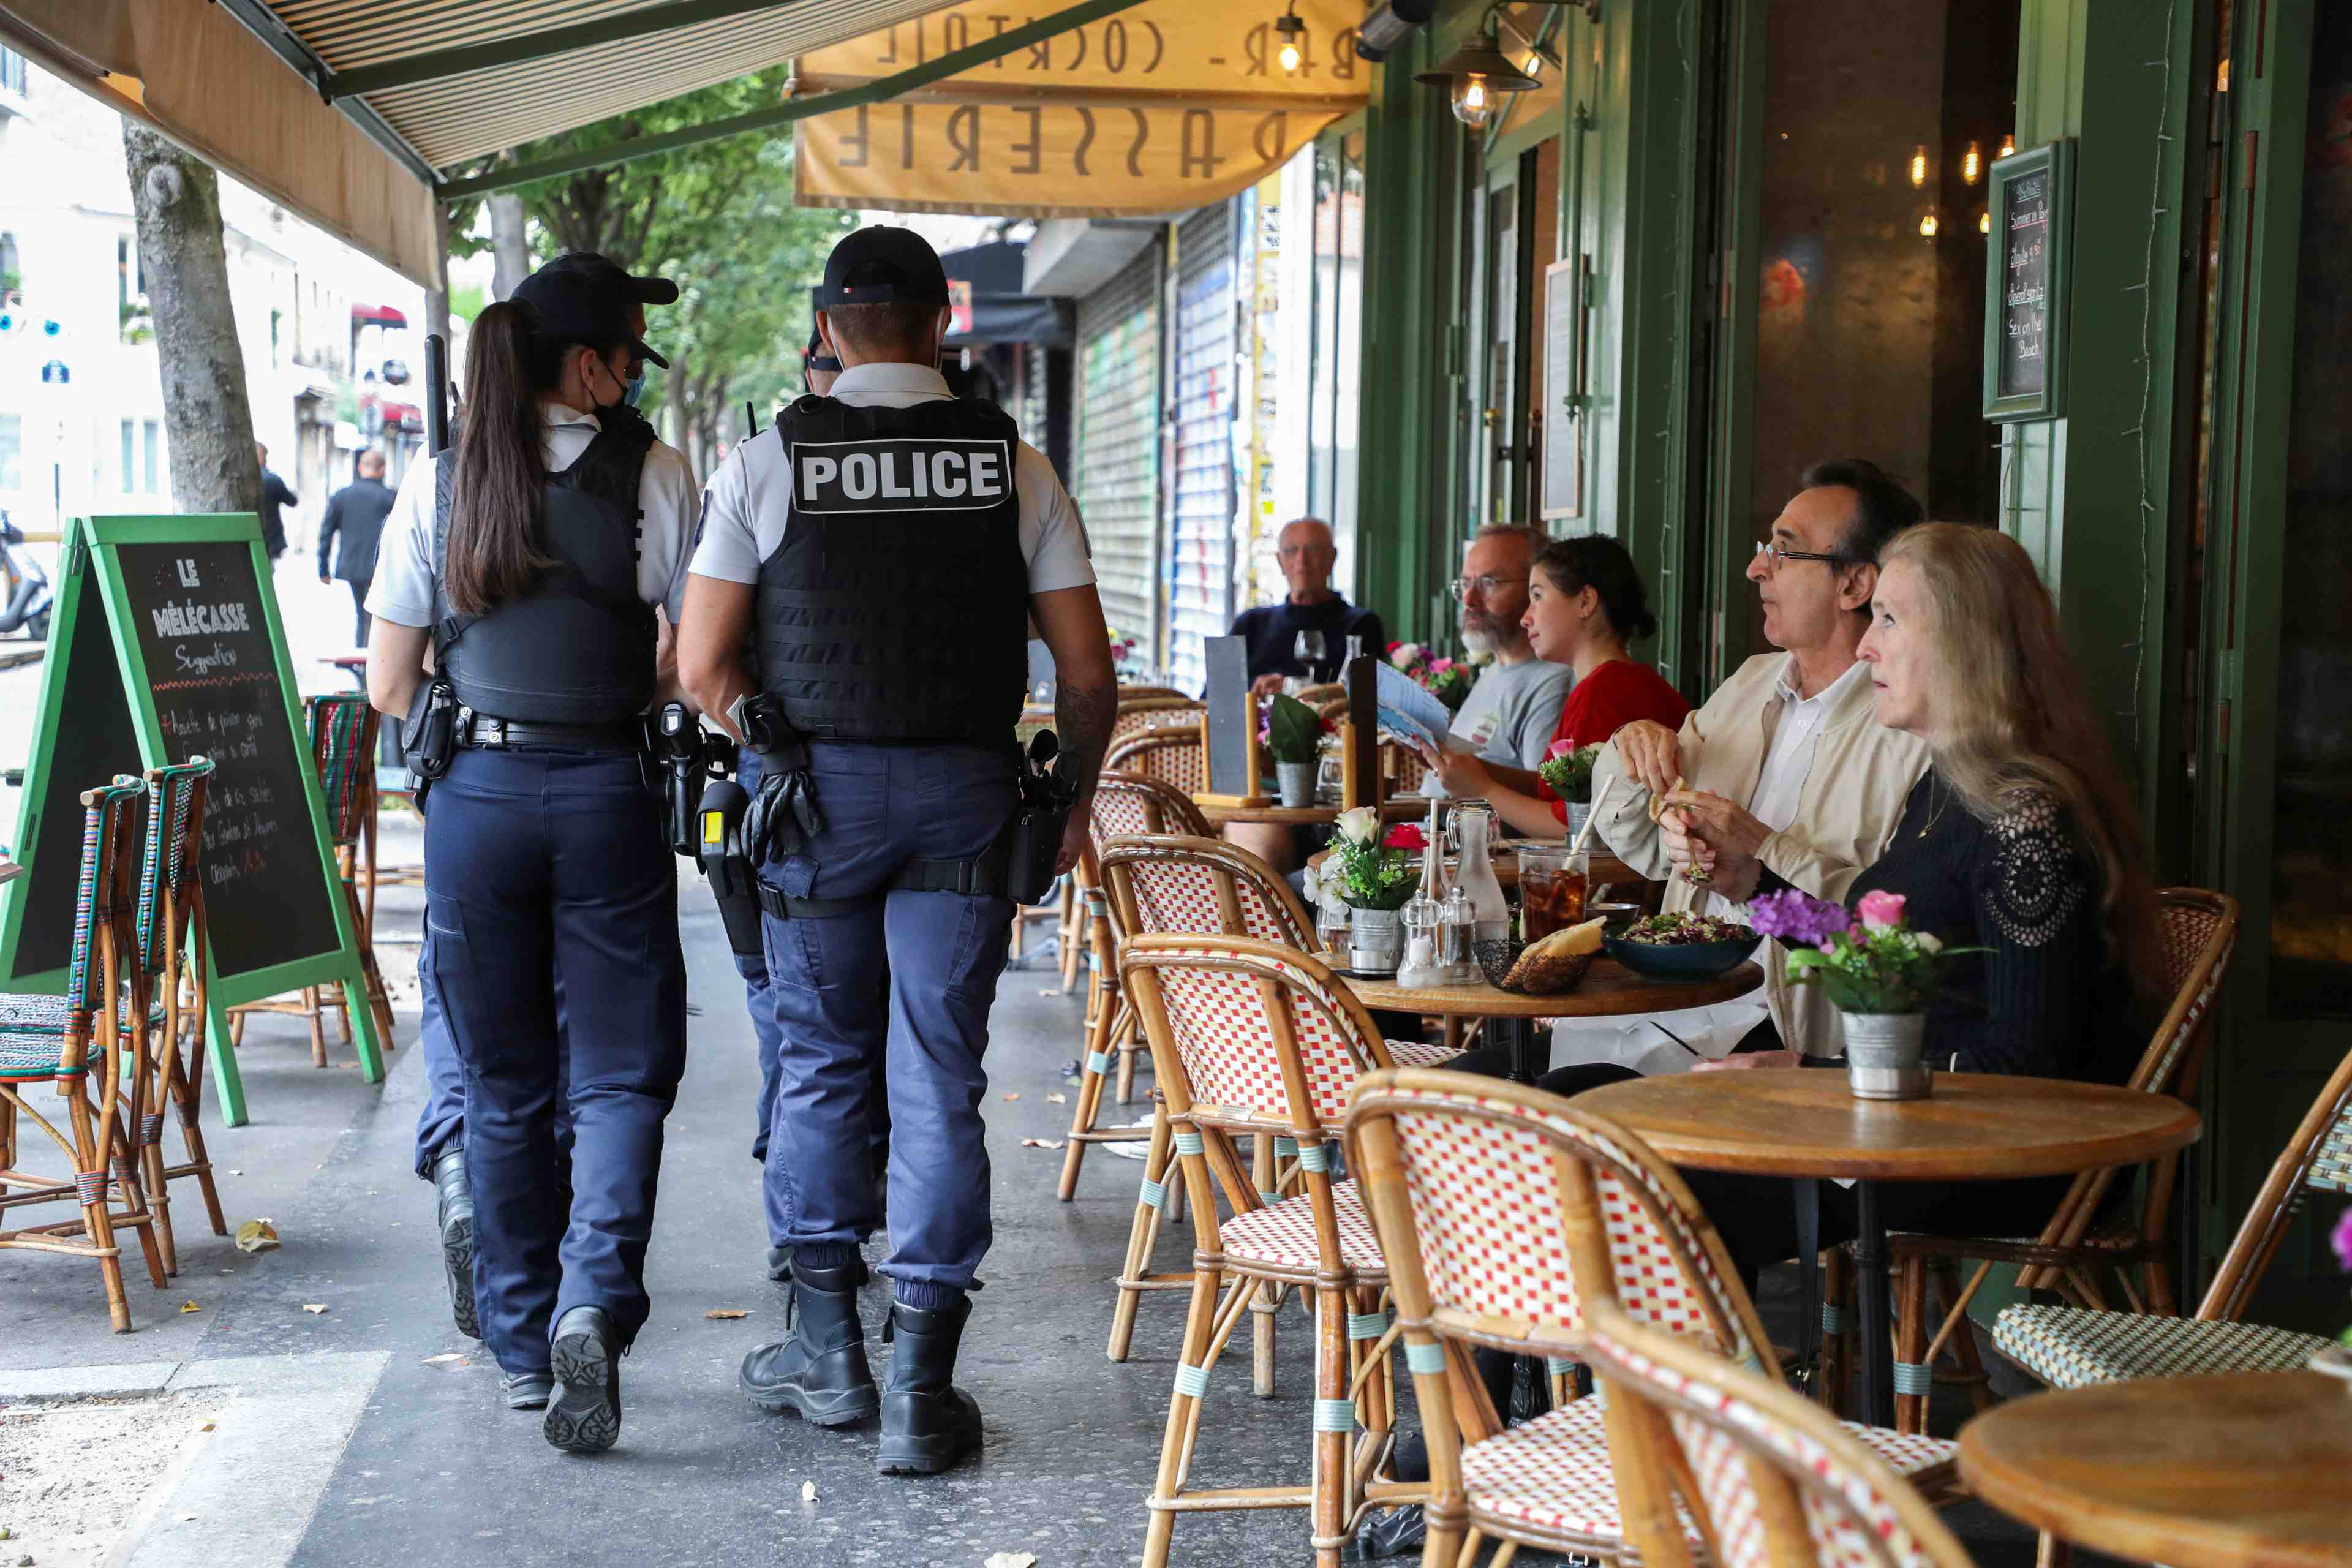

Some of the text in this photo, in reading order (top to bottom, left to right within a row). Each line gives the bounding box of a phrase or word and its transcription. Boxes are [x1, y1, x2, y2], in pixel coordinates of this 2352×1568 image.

[2009, 313, 2042, 335] Sex on the
[2019, 335, 2039, 356] Beach
[802, 451, 1002, 500] POLICE
[176, 559, 201, 587] LE
[151, 597, 250, 638] MÊLÉCASSE
